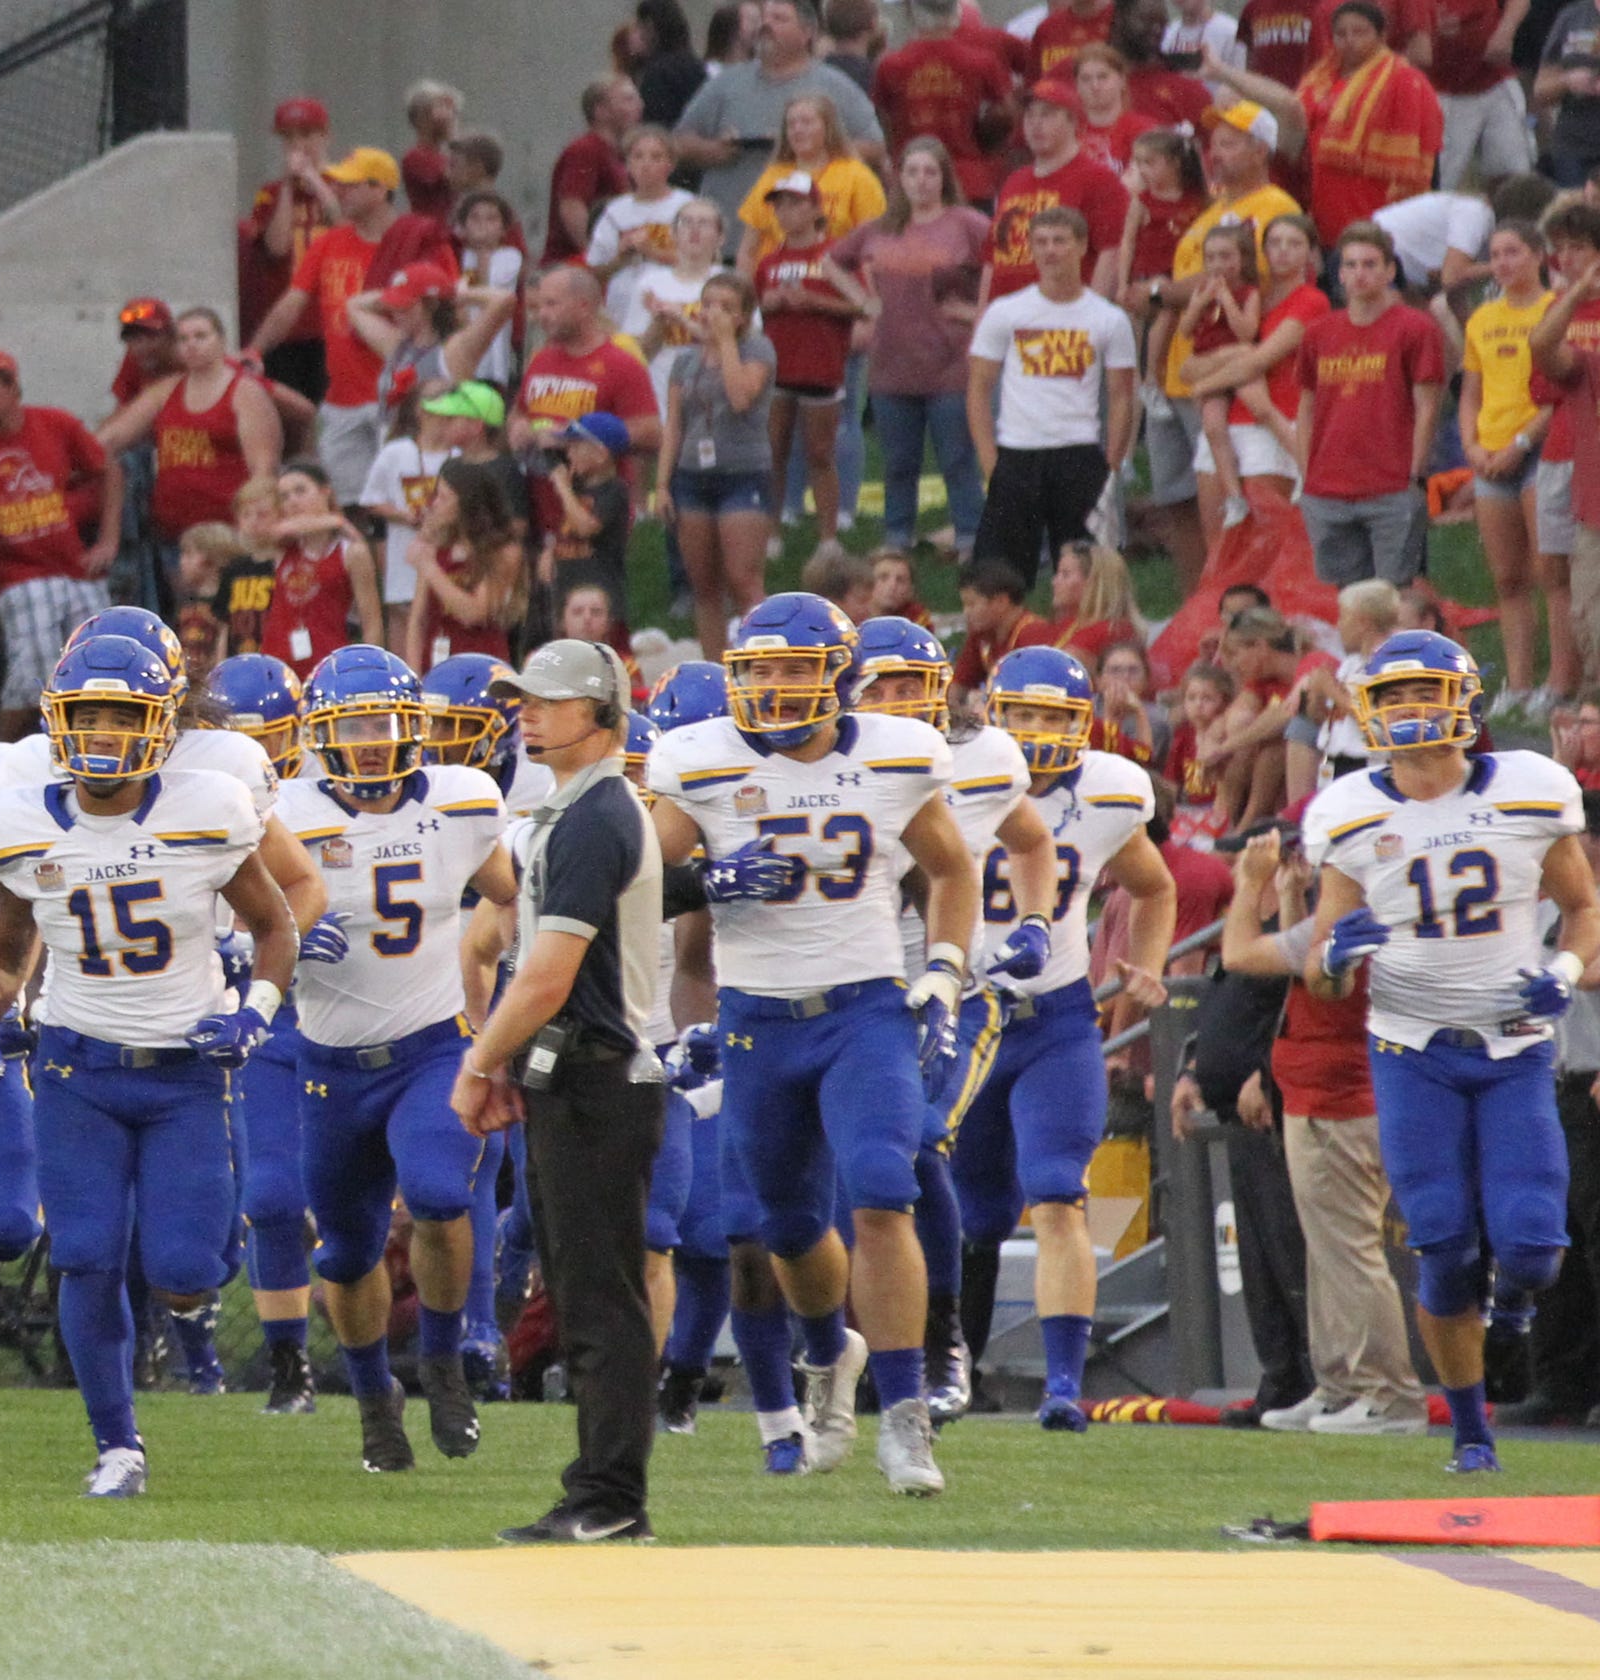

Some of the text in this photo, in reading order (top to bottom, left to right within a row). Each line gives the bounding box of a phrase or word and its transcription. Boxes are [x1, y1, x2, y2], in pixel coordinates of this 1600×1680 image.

[787, 794, 841, 809] JACKS
[373, 842, 423, 860] JACKS
[756, 811, 875, 905] 53
[1423, 831, 1474, 849] JACKS
[84, 862, 138, 882] JACKS
[1407, 847, 1503, 940] 12
[67, 877, 176, 978] 15
[370, 860, 425, 959] 5
